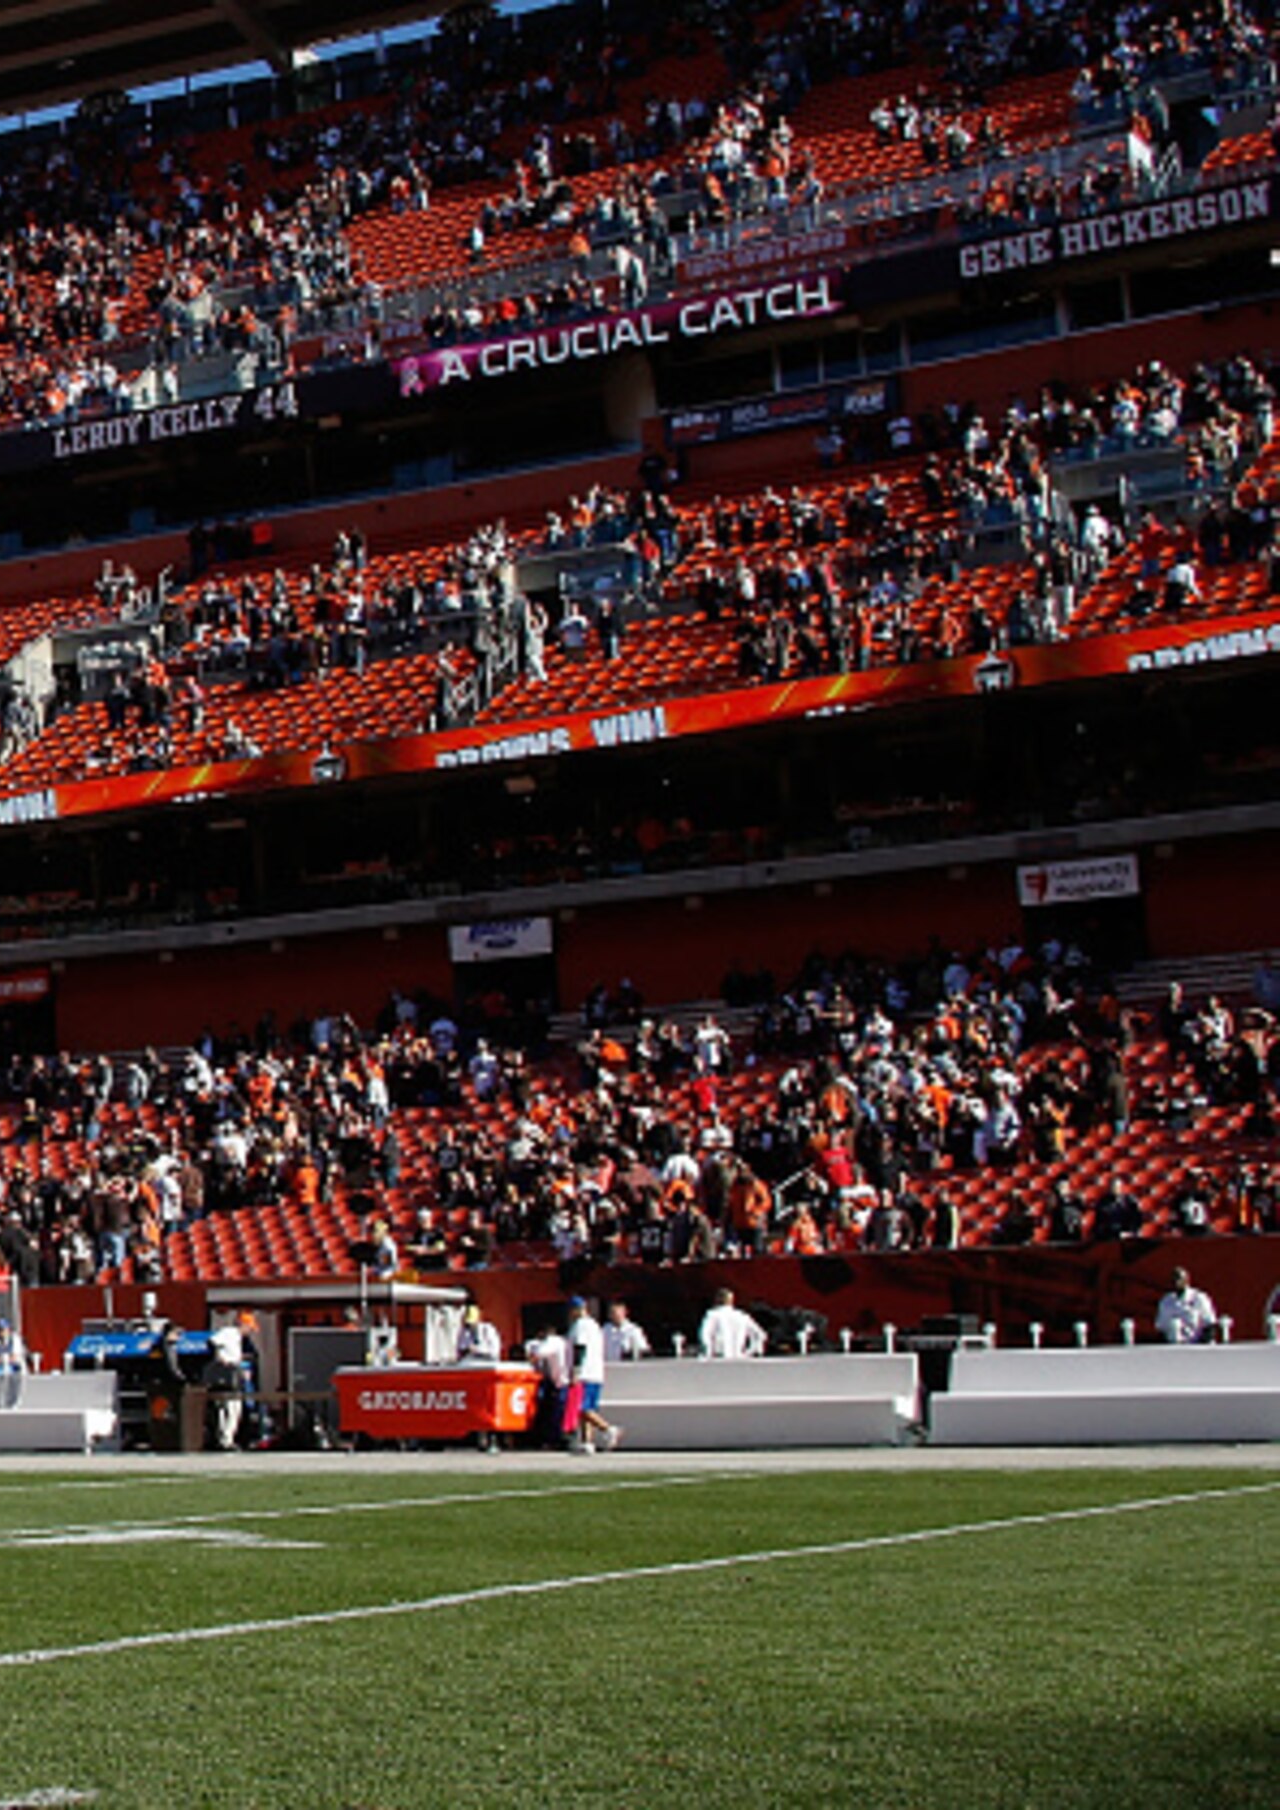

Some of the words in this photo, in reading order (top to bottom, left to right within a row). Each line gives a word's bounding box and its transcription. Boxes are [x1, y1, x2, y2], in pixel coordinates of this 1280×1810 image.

[960, 229, 1052, 278] GENE
[1060, 181, 1271, 257] HICKERSON
[439, 350, 471, 385] A
[480, 313, 669, 377] CRUCIAL
[679, 276, 831, 336] CATCH
[53, 413, 144, 458] LEROY
[150, 396, 243, 441] KELLY
[253, 382, 299, 420] 44
[358, 1390, 468, 1411] GATORADE
[510, 1386, 527, 1415] G
